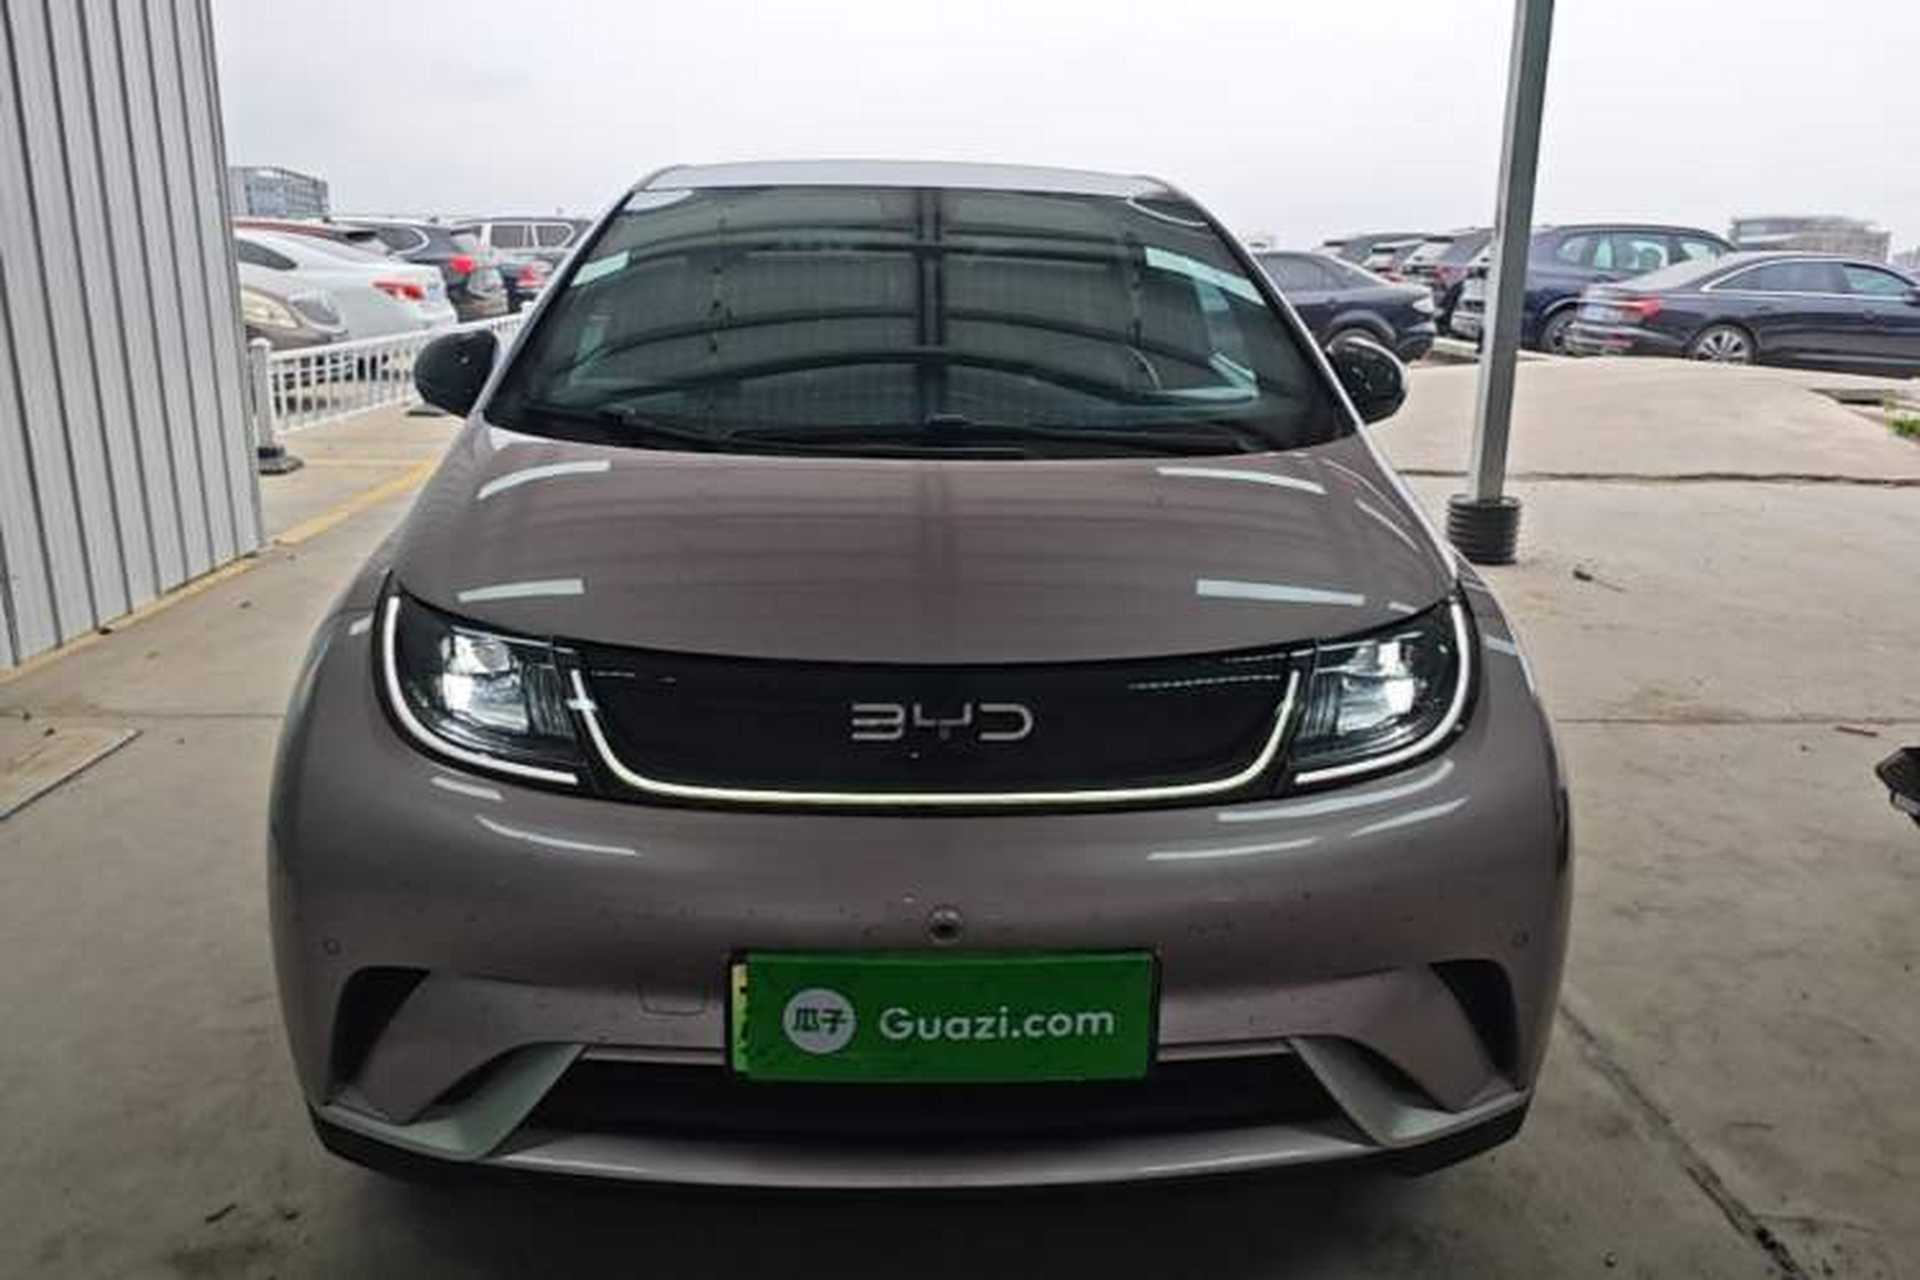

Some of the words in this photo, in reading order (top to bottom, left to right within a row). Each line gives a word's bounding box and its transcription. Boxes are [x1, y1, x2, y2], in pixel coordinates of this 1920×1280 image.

[852, 703, 1033, 740] BYD
[792, 1007, 848, 1034] 瓜子
[879, 1006, 1115, 1040] Guazi.com
